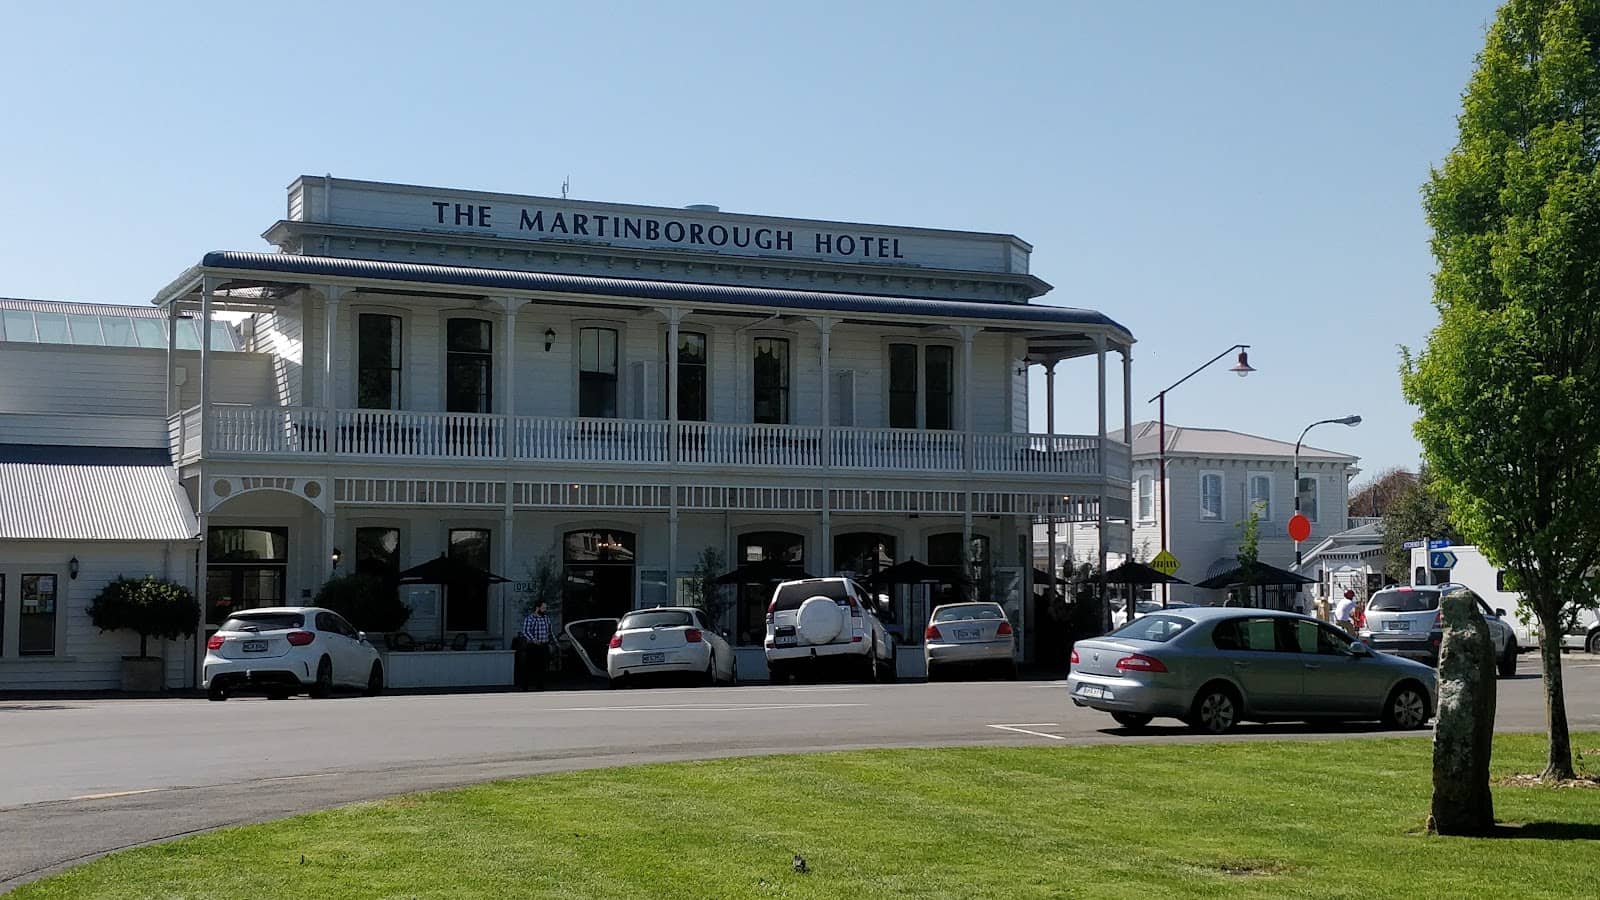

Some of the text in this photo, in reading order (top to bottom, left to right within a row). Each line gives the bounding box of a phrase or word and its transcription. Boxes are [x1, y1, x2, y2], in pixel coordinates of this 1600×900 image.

[432, 201, 904, 259] THE MARTINBOROUGH HOTEL
